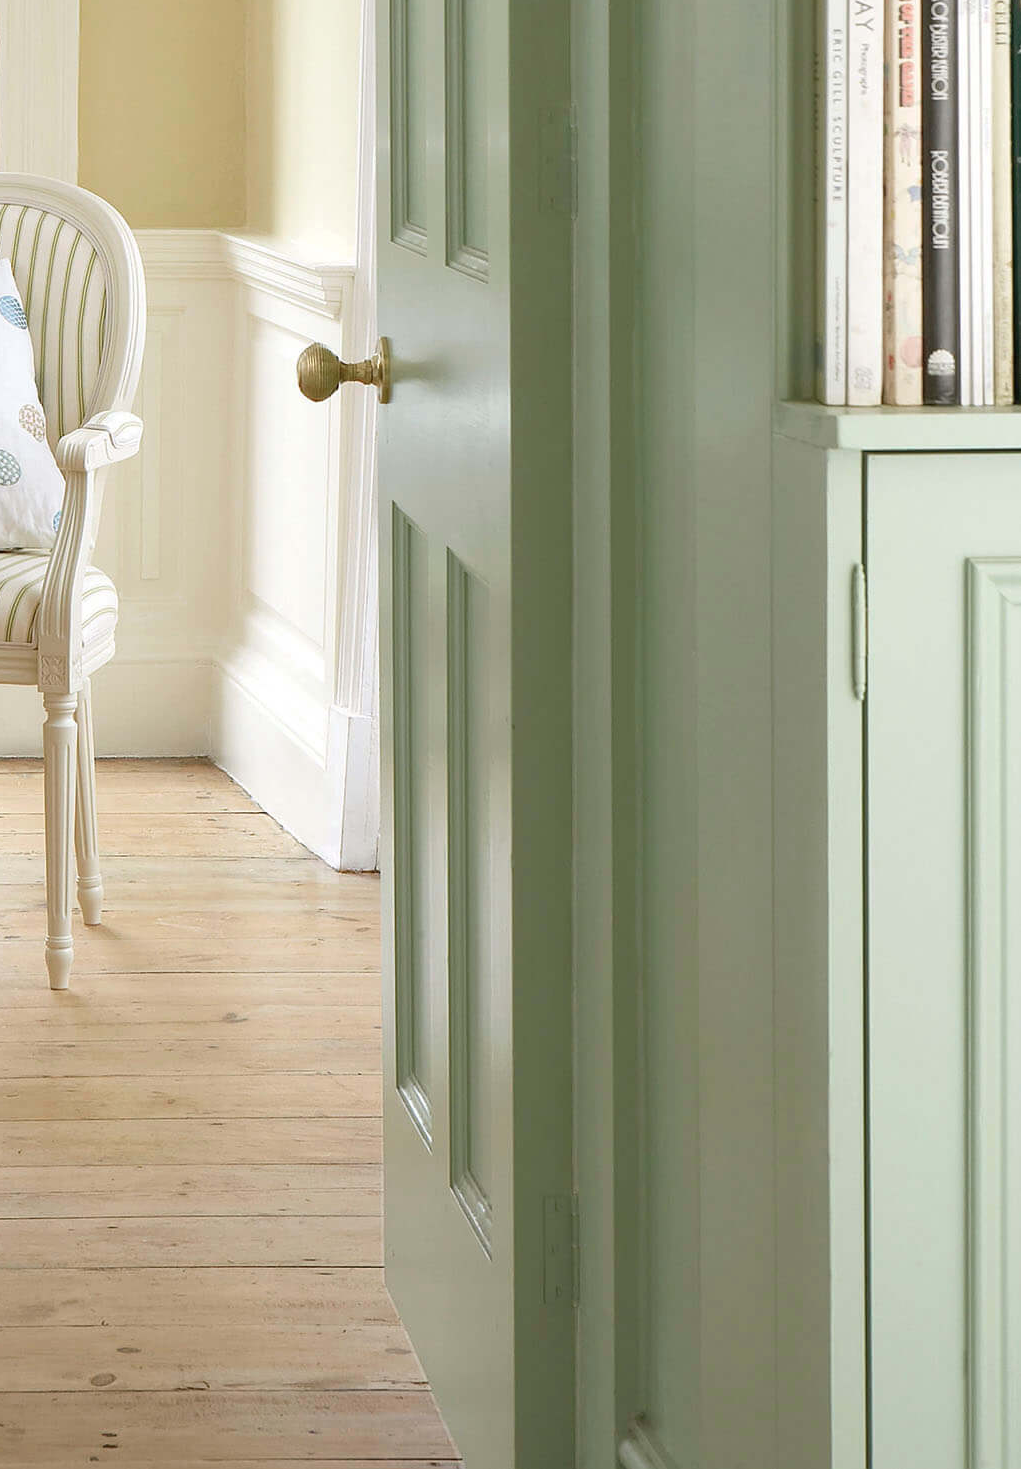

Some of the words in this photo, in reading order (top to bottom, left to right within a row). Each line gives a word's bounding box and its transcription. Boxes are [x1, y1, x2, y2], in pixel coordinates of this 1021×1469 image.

[832, 28, 842, 63] ERIC
[832, 70, 842, 104] GILL
[832, 115, 842, 202] SCULPTURE
